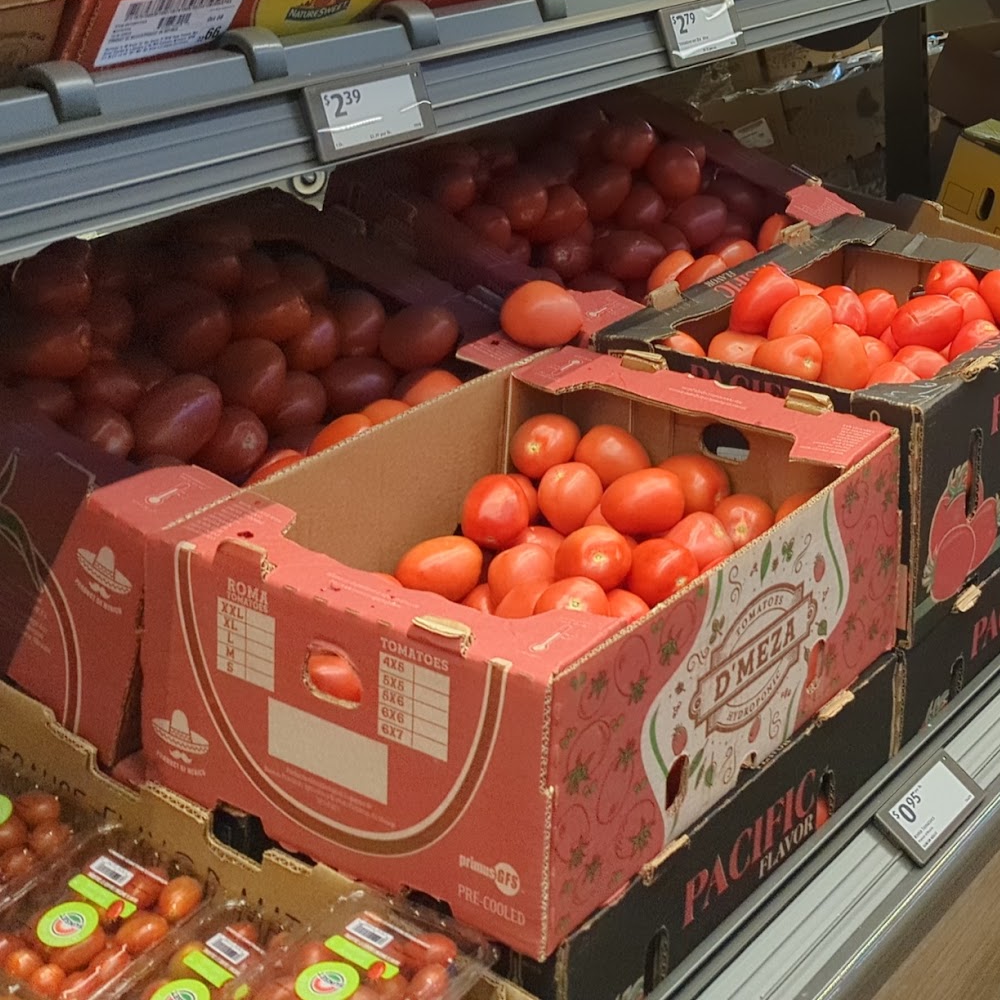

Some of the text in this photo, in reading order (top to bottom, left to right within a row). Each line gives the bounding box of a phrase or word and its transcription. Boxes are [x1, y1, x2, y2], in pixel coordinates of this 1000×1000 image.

[227, 577, 268, 605] ROMA
[227, 590, 269, 614] TOMATOES
[221, 601, 244, 620] XXL
[223, 616, 238, 631] XL
[735, 595, 785, 636] TOMATOES
[227, 631, 234, 645] L
[226, 645, 235, 660] M
[380, 636, 449, 672] TOMATOES
[715, 617, 796, 701] D'MEZA
[226, 661, 234, 673] S
[726, 669, 782, 722] HYDROPONIC
[381, 706, 405, 724] 6X6
[381, 723, 404, 740] 6X7
[682, 768, 817, 928] PACIFIC
[758, 811, 817, 880] FLAVOR
[458, 884, 526, 927] PRE-COOLED
